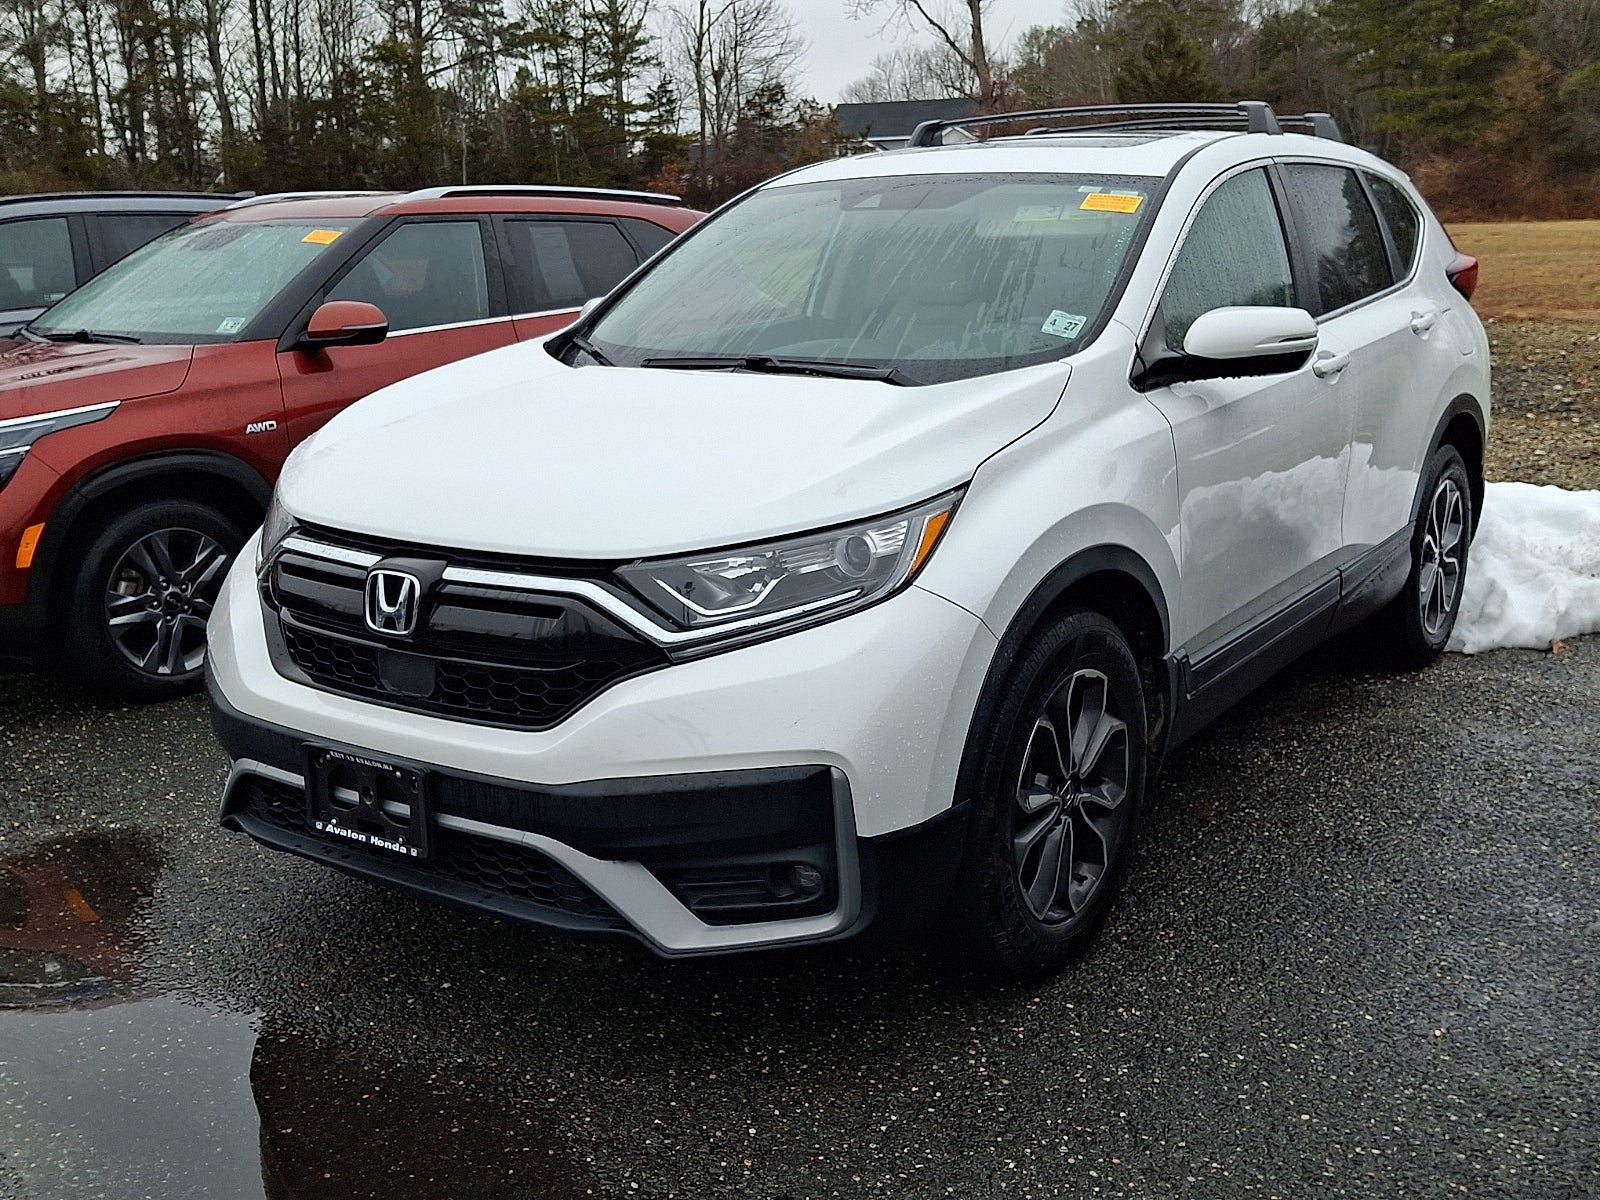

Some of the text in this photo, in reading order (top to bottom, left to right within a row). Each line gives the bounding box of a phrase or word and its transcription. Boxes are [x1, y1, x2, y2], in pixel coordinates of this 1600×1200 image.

[1063, 321, 1080, 332] 27
[245, 420, 277, 434] AWD
[325, 823, 407, 854] Avalon Honda
